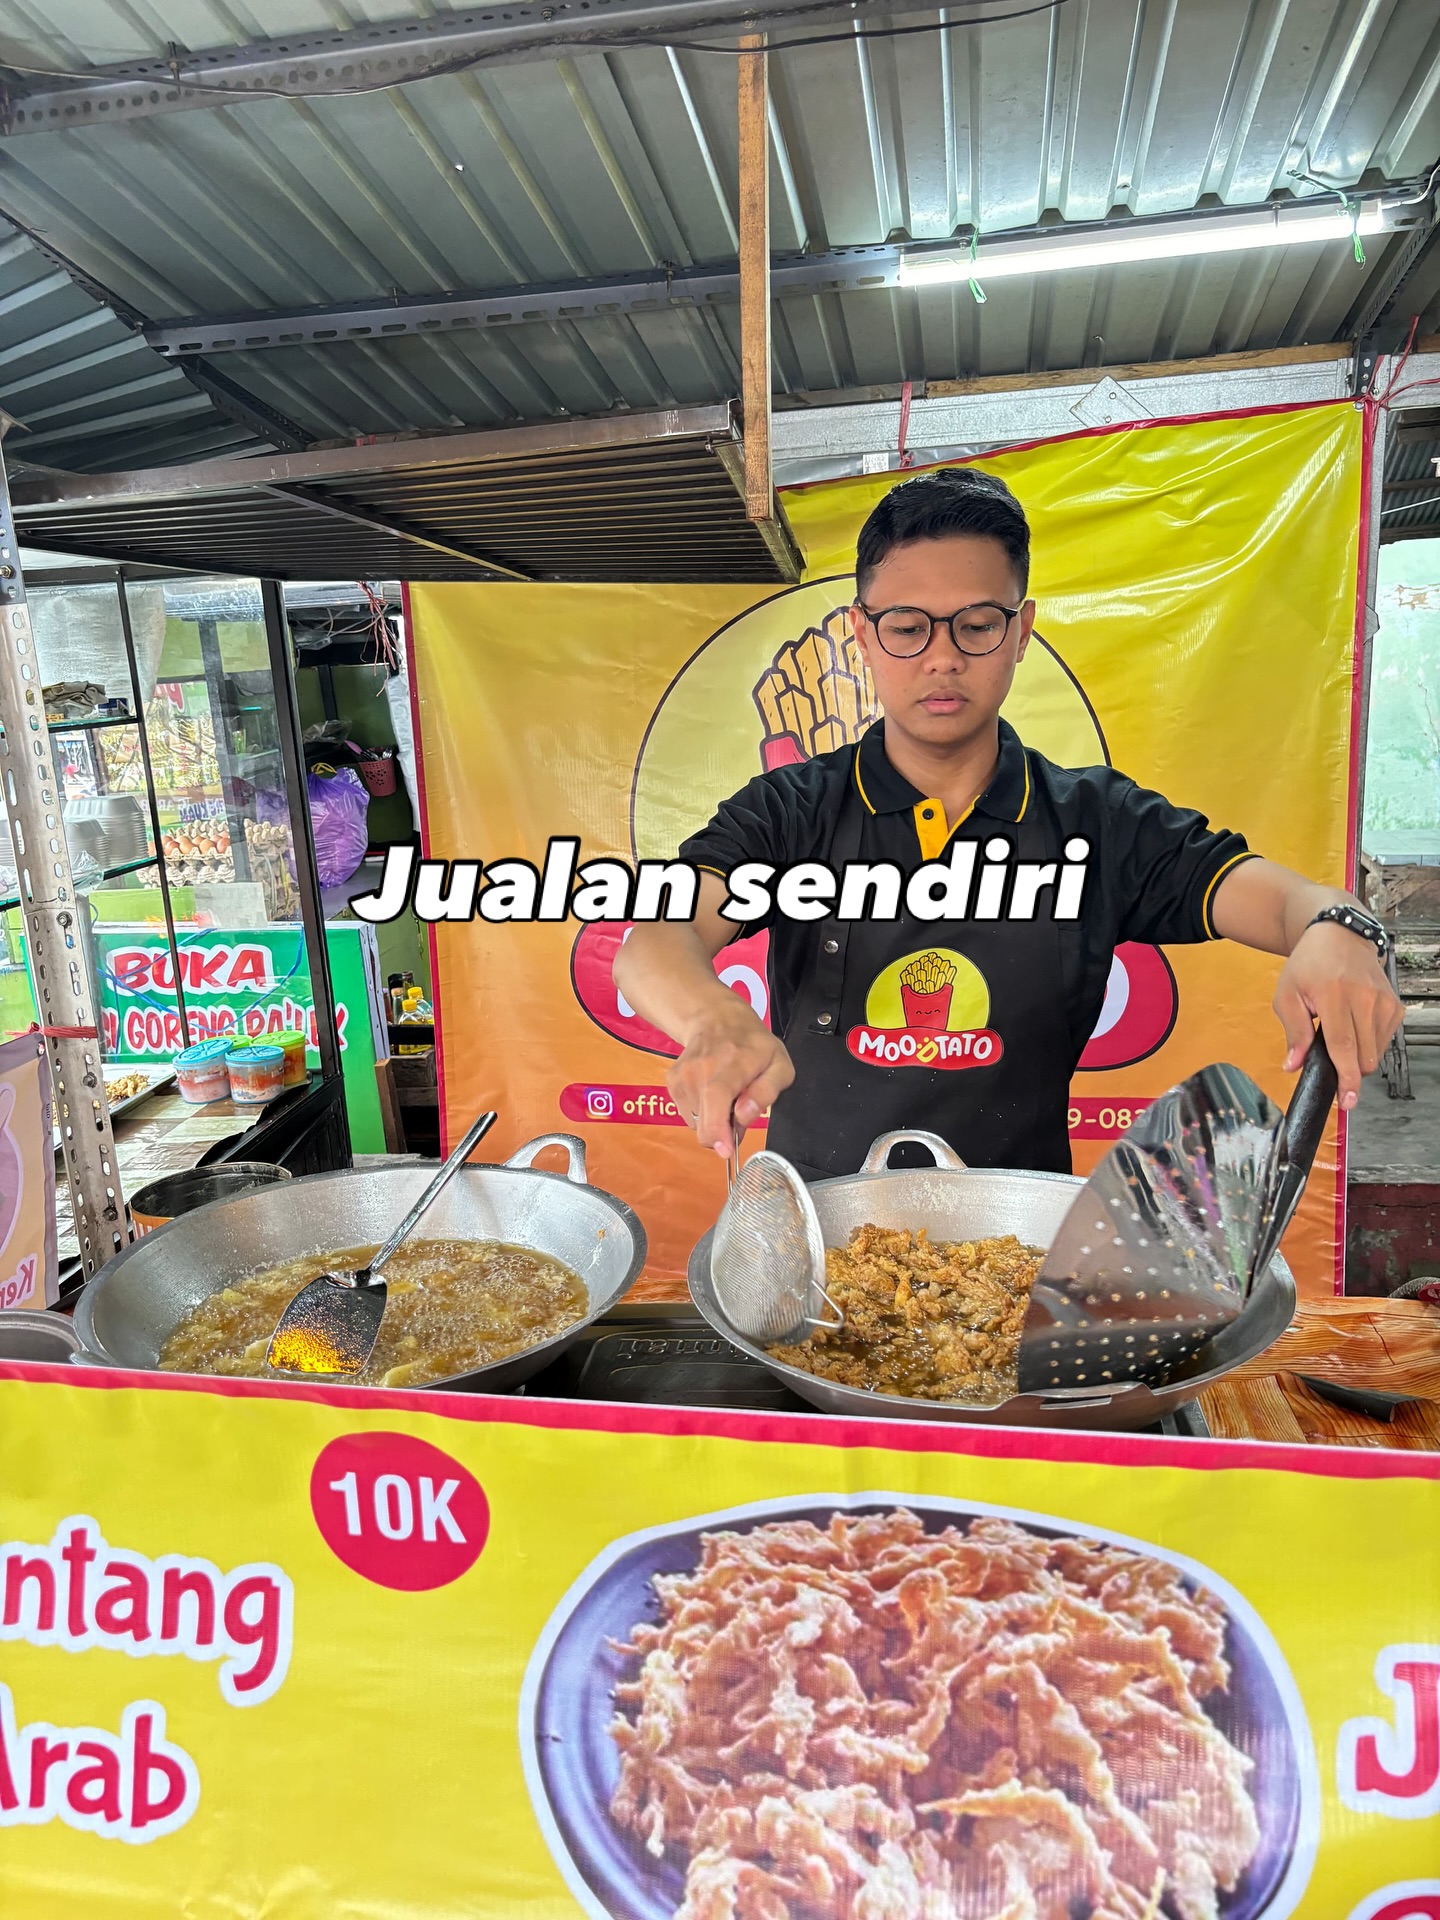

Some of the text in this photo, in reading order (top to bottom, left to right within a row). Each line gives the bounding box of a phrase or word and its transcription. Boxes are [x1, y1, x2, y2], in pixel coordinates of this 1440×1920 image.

[114, 949, 267, 990] BUKA
[127, 1009, 236, 1050] GORENG
[329, 1471, 467, 1544] 10K
[2, 1527, 282, 1692] ntang
